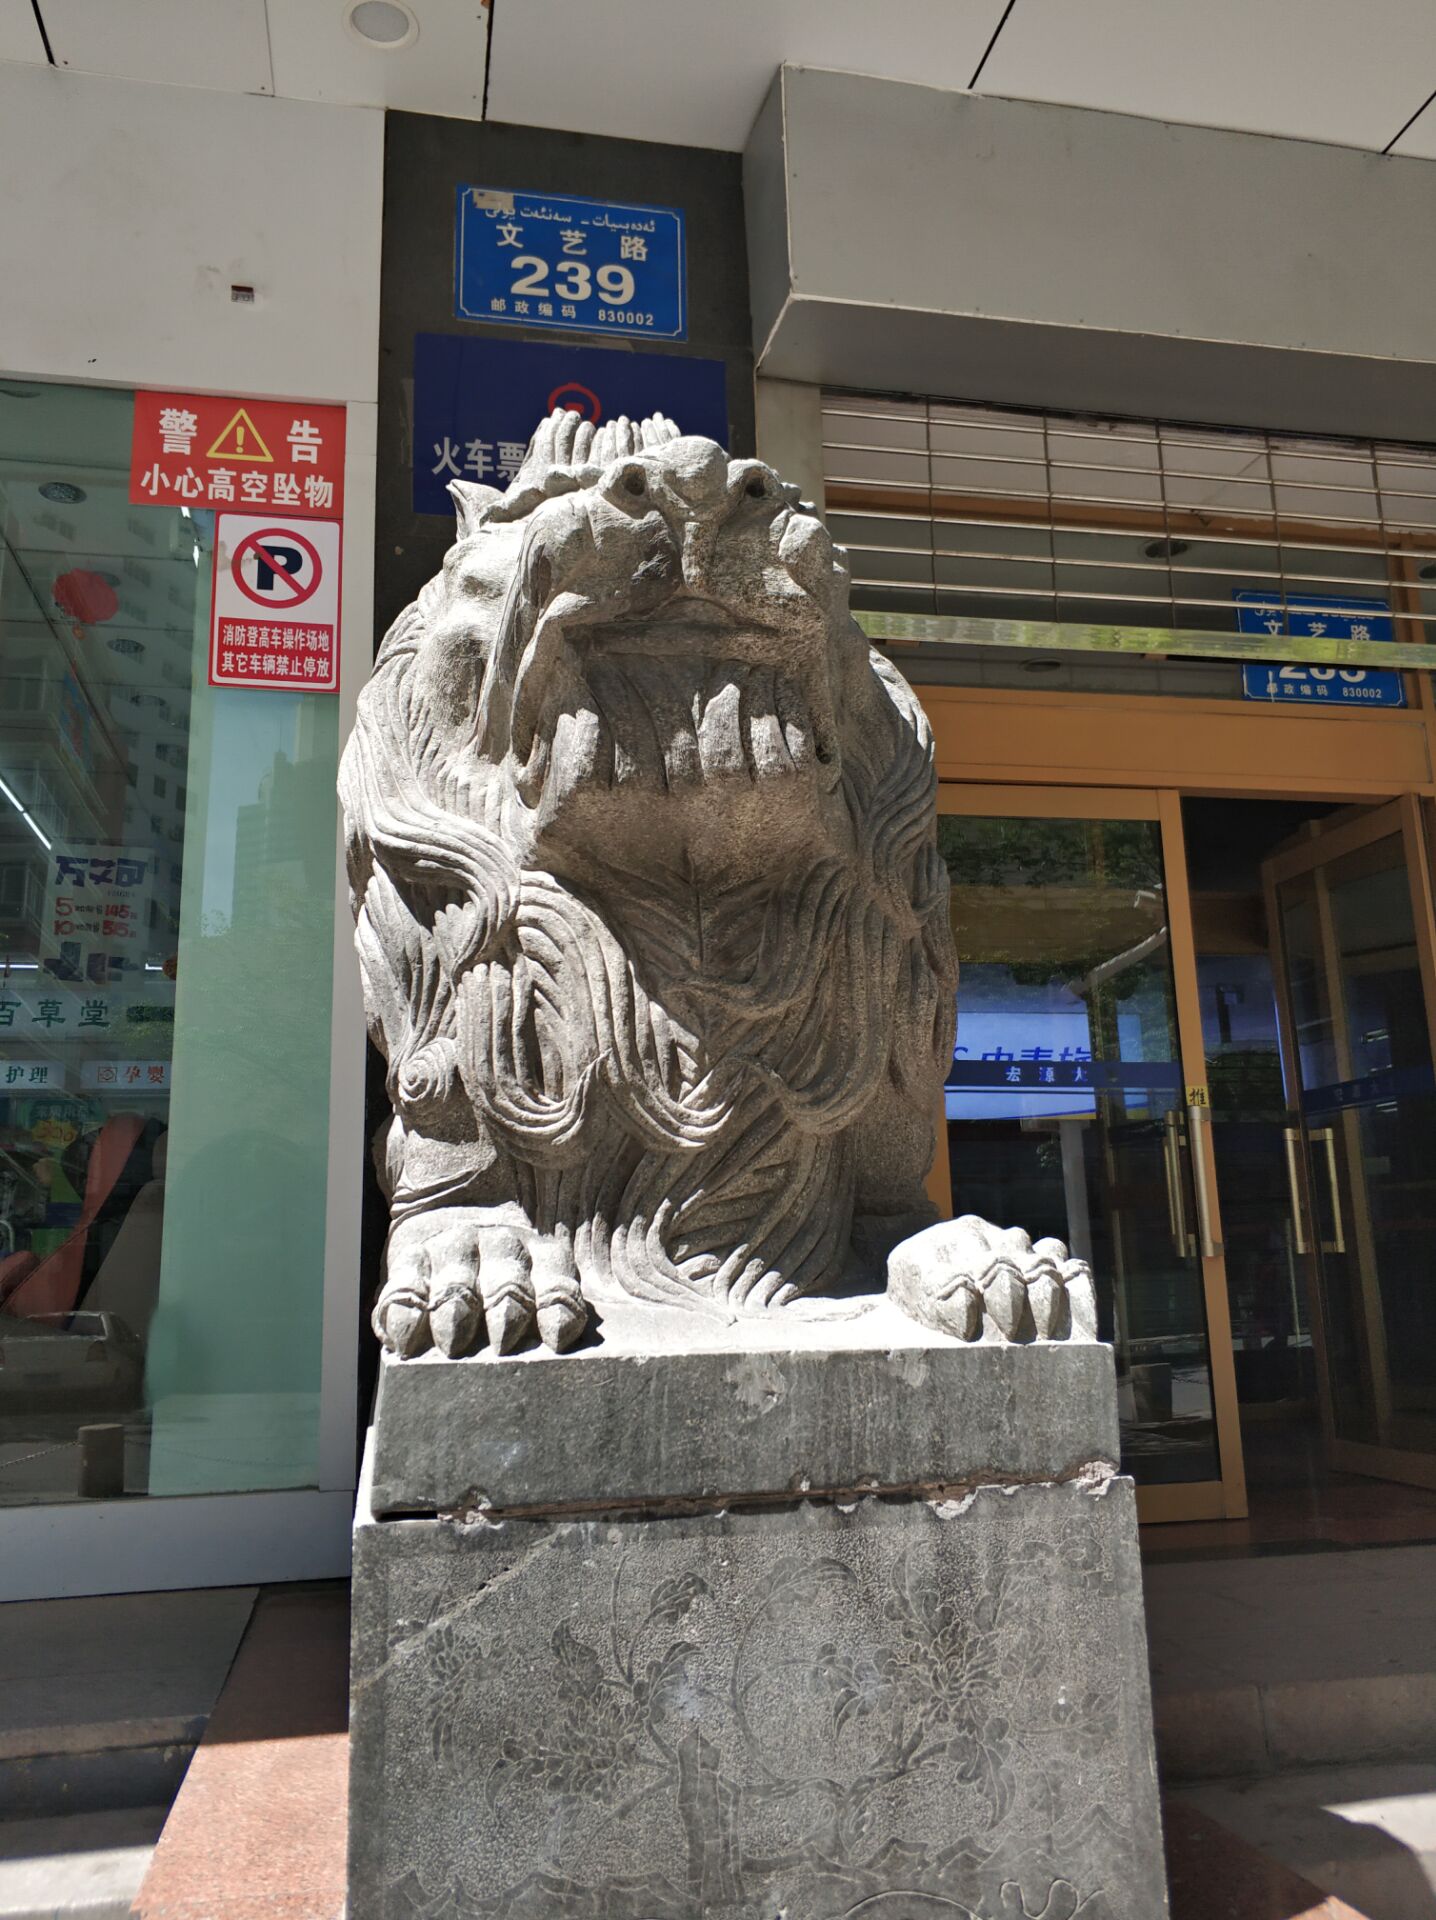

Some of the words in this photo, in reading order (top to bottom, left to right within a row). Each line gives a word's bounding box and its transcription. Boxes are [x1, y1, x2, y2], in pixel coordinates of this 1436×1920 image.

[496, 223, 648, 263] 文艺路
[510, 256, 635, 305] 239
[490, 298, 577, 319] 邮政编码
[597, 309, 655, 326] 830002
[431, 437, 527, 482] 火车票
[140, 463, 334, 509] 小心高空坠物
[222, 624, 330, 653] 消防登高车操作场地
[221, 650, 330, 678] 其它车辆禁止停放
[1342, 686, 1382, 699] 830002
[0, 999, 110, 1028] 百草堂
[6, 1066, 49, 1084] 护理
[125, 1065, 165, 1084] 孕婴
